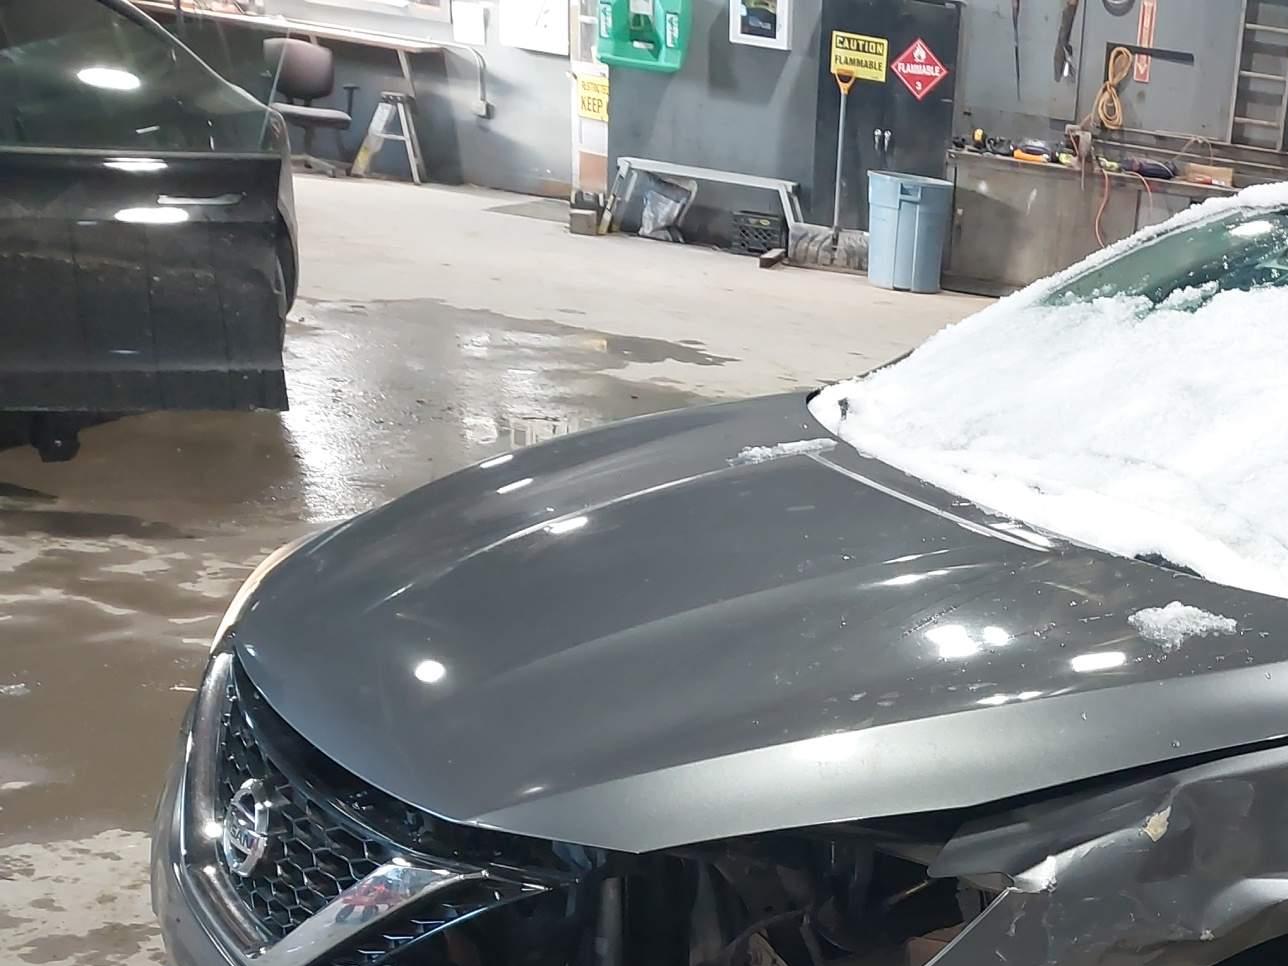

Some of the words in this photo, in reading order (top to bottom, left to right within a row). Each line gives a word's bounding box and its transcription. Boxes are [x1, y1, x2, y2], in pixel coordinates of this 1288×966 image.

[836, 37, 884, 55] CAUTION
[834, 54, 883, 72] FLAMMABLE
[897, 62, 941, 76] FLAMMABLE
[915, 81, 923, 91] 3
[581, 95, 603, 113] KEEP
